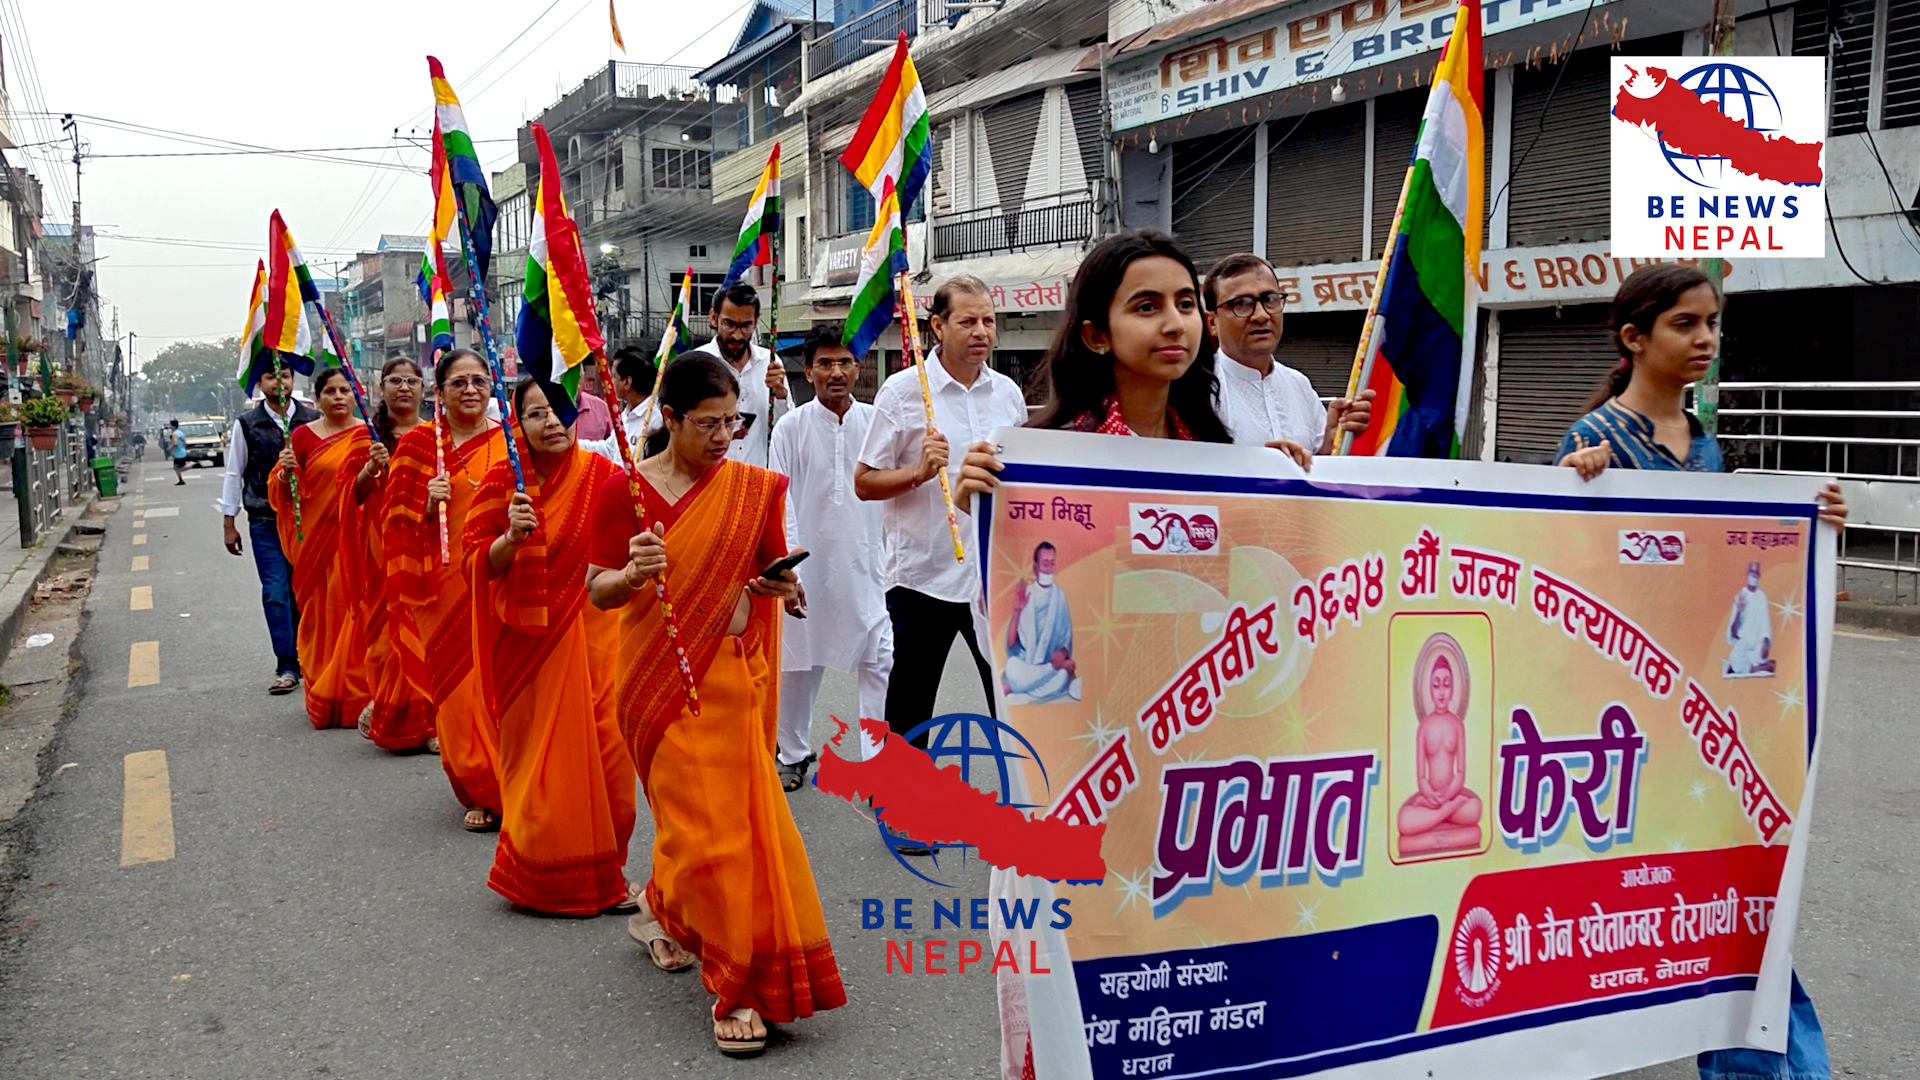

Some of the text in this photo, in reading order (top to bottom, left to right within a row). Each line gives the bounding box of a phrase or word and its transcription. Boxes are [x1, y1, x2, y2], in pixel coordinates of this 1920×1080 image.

[1159, 27, 1278, 88] शिव
[1177, 65, 1270, 108] SHIV
[1296, 51, 1324, 77] &
[829, 247, 858, 271] VARIETY
[1505, 260, 1526, 290] &
[1013, 281, 1062, 308] स्टोर्स
[1008, 501, 1045, 520] जय
[1727, 530, 1748, 546] जय
[1141, 606, 1279, 749] महावीर
[1293, 557, 1384, 643] २६२४
[1450, 549, 1521, 604] जन्म
[1532, 569, 1680, 696] कल्याणक
[1682, 682, 1792, 842] महोत्सव
[1500, 705, 1644, 838] फेरी
[1152, 754, 1375, 901] प्रभात
[1504, 913, 1532, 971] श्री
[1537, 906, 1574, 963] जैन
[1578, 902, 1665, 958] श्वेताम्बर
[1670, 887, 1739, 943] तेरापंथी
[1099, 960, 1171, 999] सहयोगी
[1590, 957, 1710, 990] धरान, नेपाल
[1128, 1006, 1203, 1045] महिला
[1209, 998, 1267, 1031] मंडल
[1122, 1053, 1175, 1076] धरान
